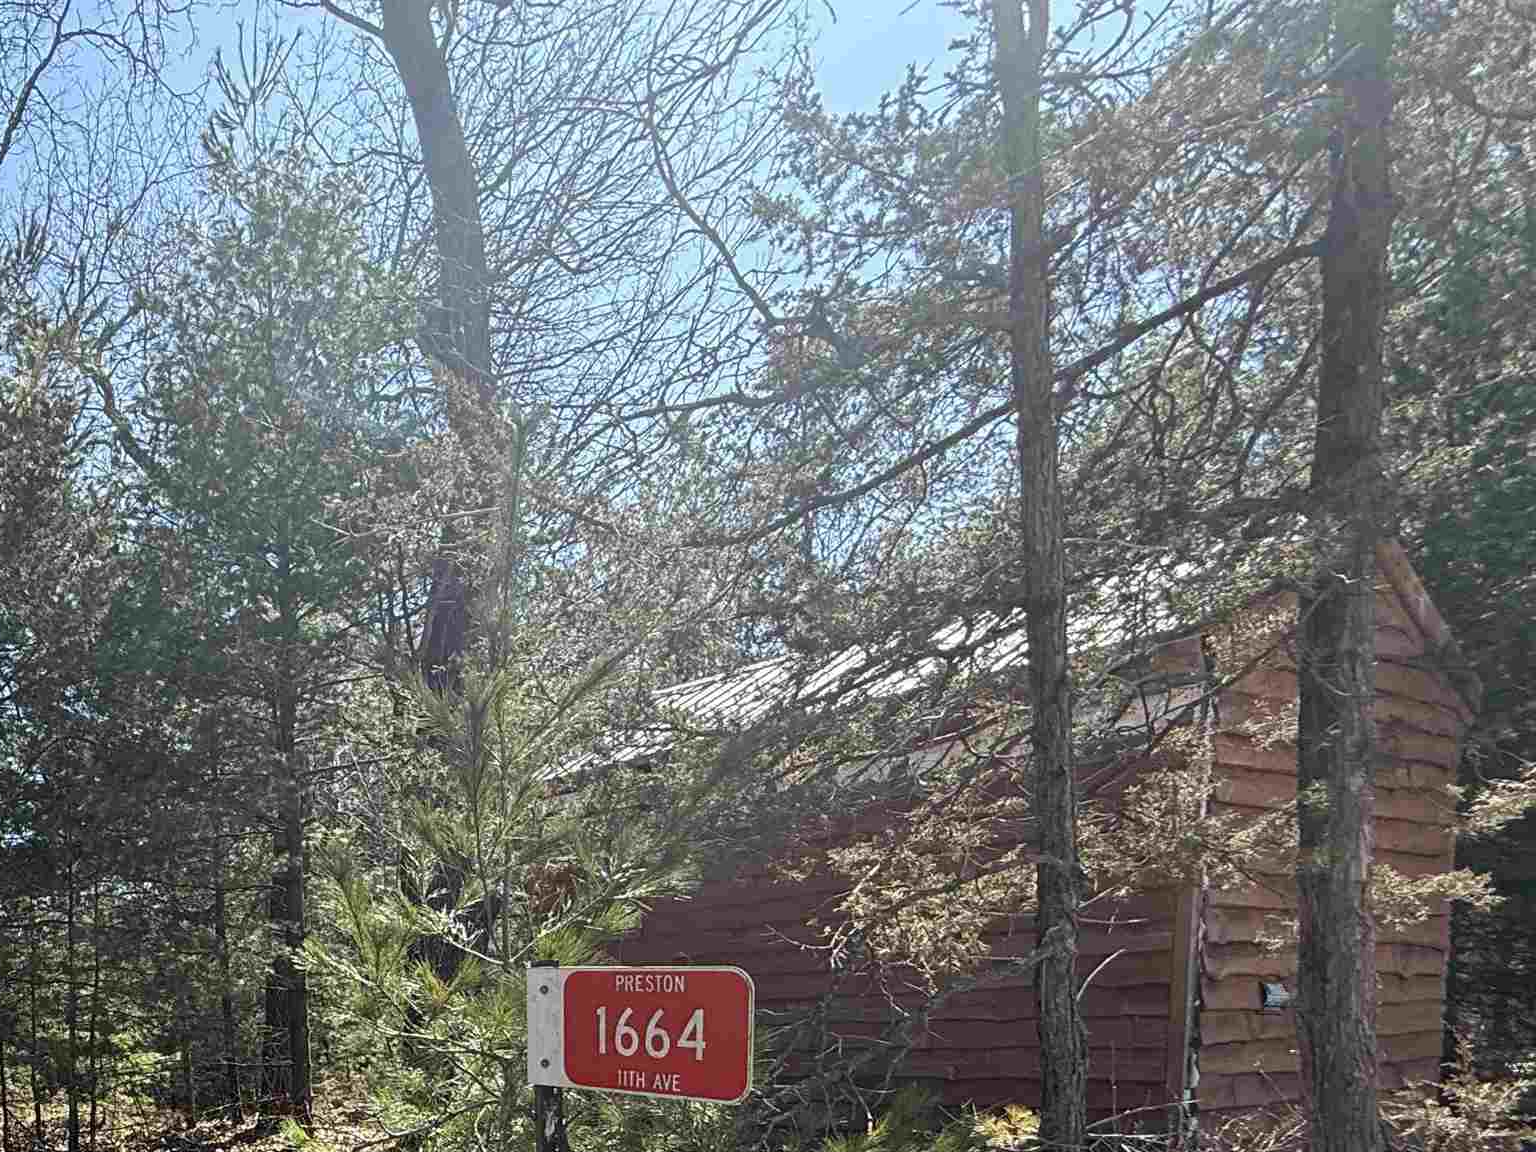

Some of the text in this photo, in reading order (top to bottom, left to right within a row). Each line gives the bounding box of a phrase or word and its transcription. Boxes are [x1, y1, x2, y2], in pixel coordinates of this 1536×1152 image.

[615, 974, 685, 992] PRESTON
[596, 1006, 706, 1061] 1664
[617, 1069, 681, 1092] 11TH AVE
